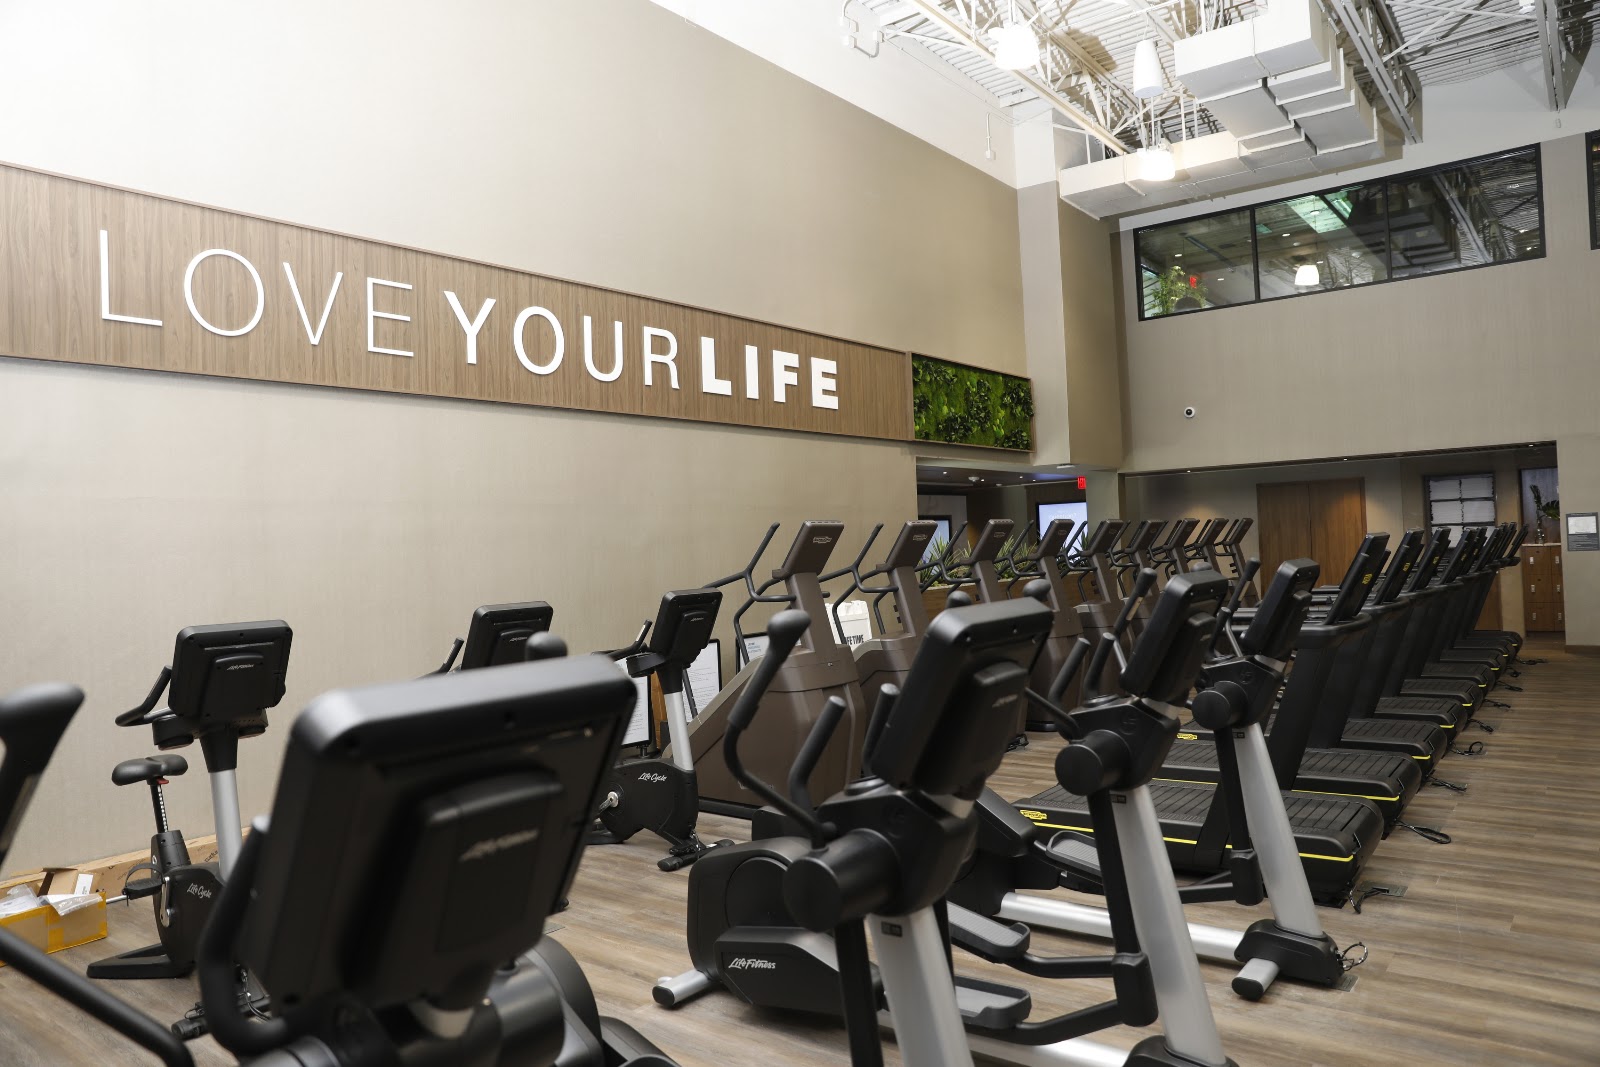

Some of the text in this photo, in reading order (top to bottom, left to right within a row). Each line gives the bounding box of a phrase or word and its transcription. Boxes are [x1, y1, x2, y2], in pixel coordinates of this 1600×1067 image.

[100, 229, 839, 410] LOVE YOUR LIFE
